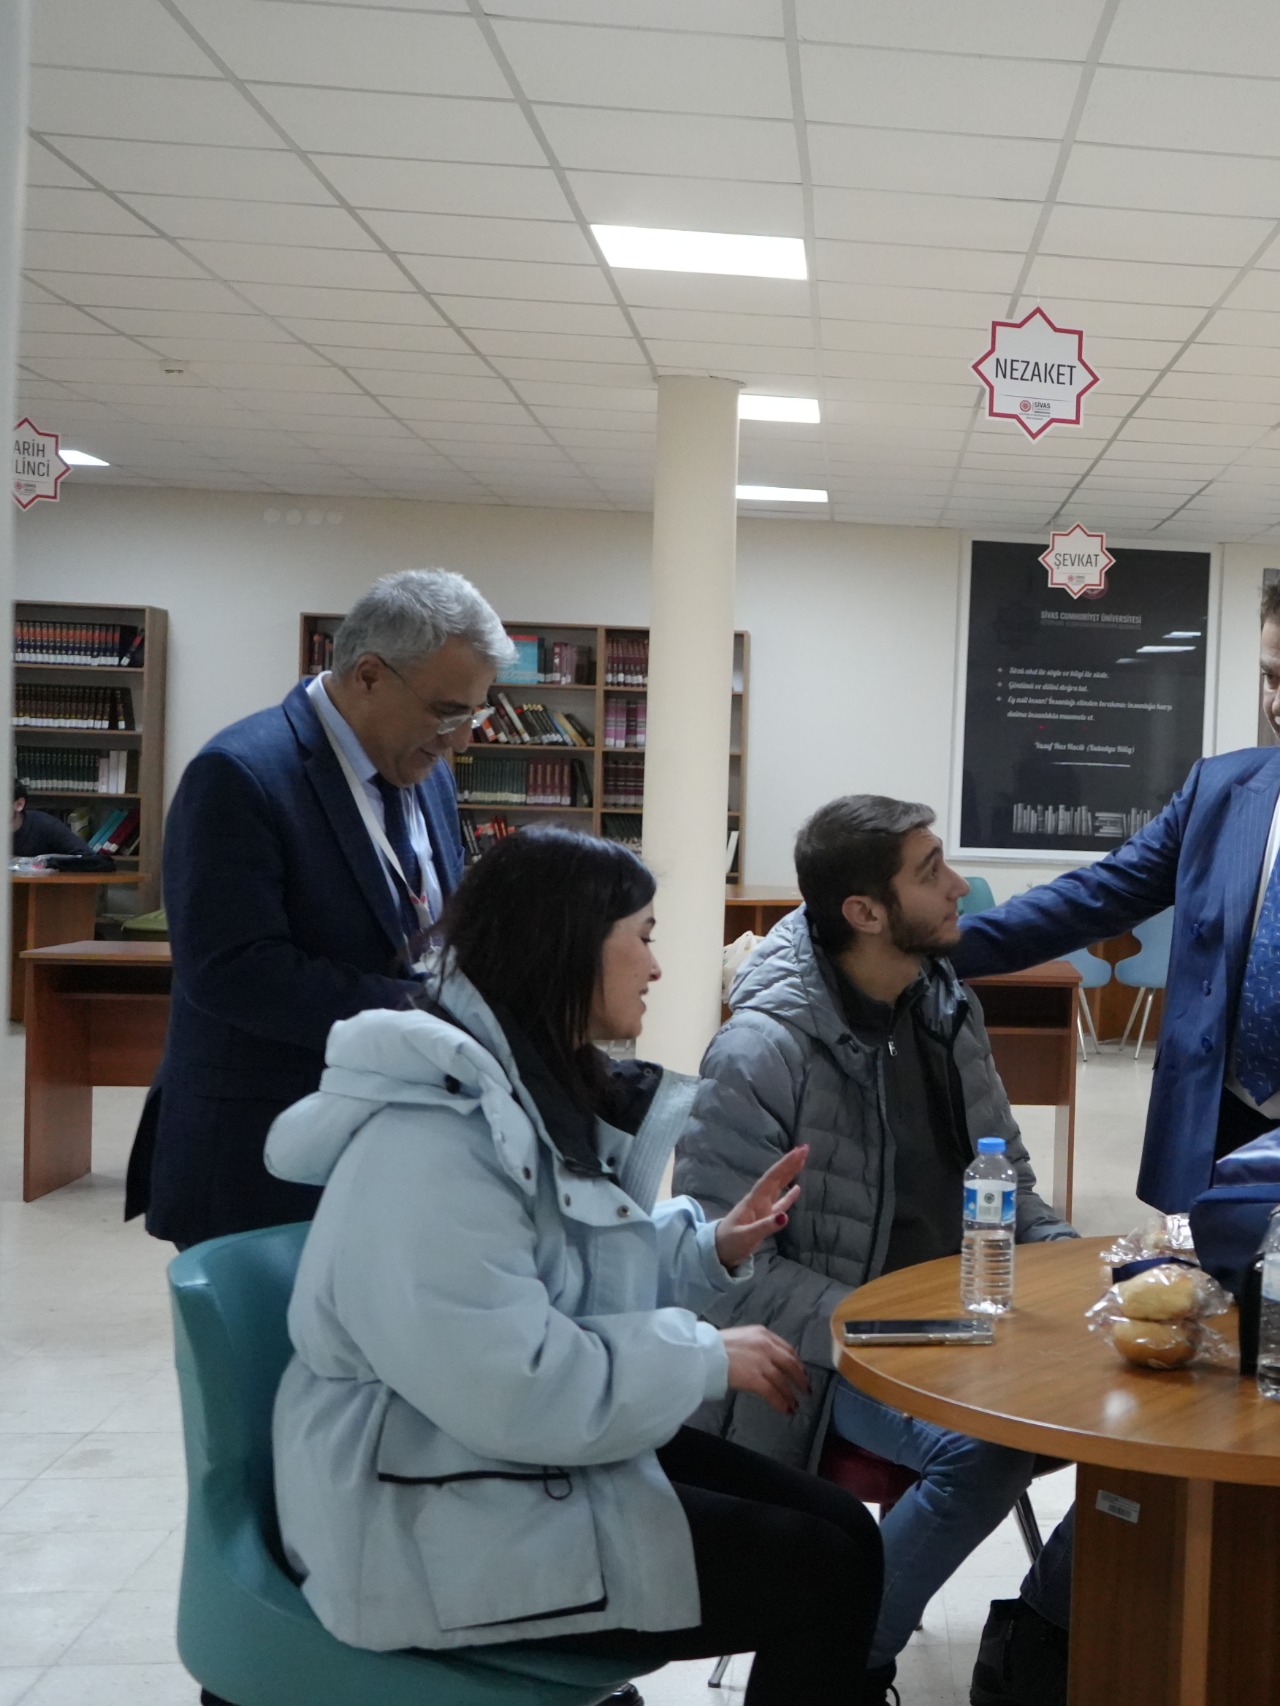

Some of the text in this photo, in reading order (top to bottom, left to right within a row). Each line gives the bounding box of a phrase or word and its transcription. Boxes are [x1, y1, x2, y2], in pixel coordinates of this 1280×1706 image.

[995, 357, 1077, 386] NEZAKET
[1034, 400, 1051, 409] SİVAS
[1054, 552, 1100, 570] ŞEVKAT
[1040, 610, 1142, 624] SİVAS CUMHURİYET ÜNİVERSİTESİ
